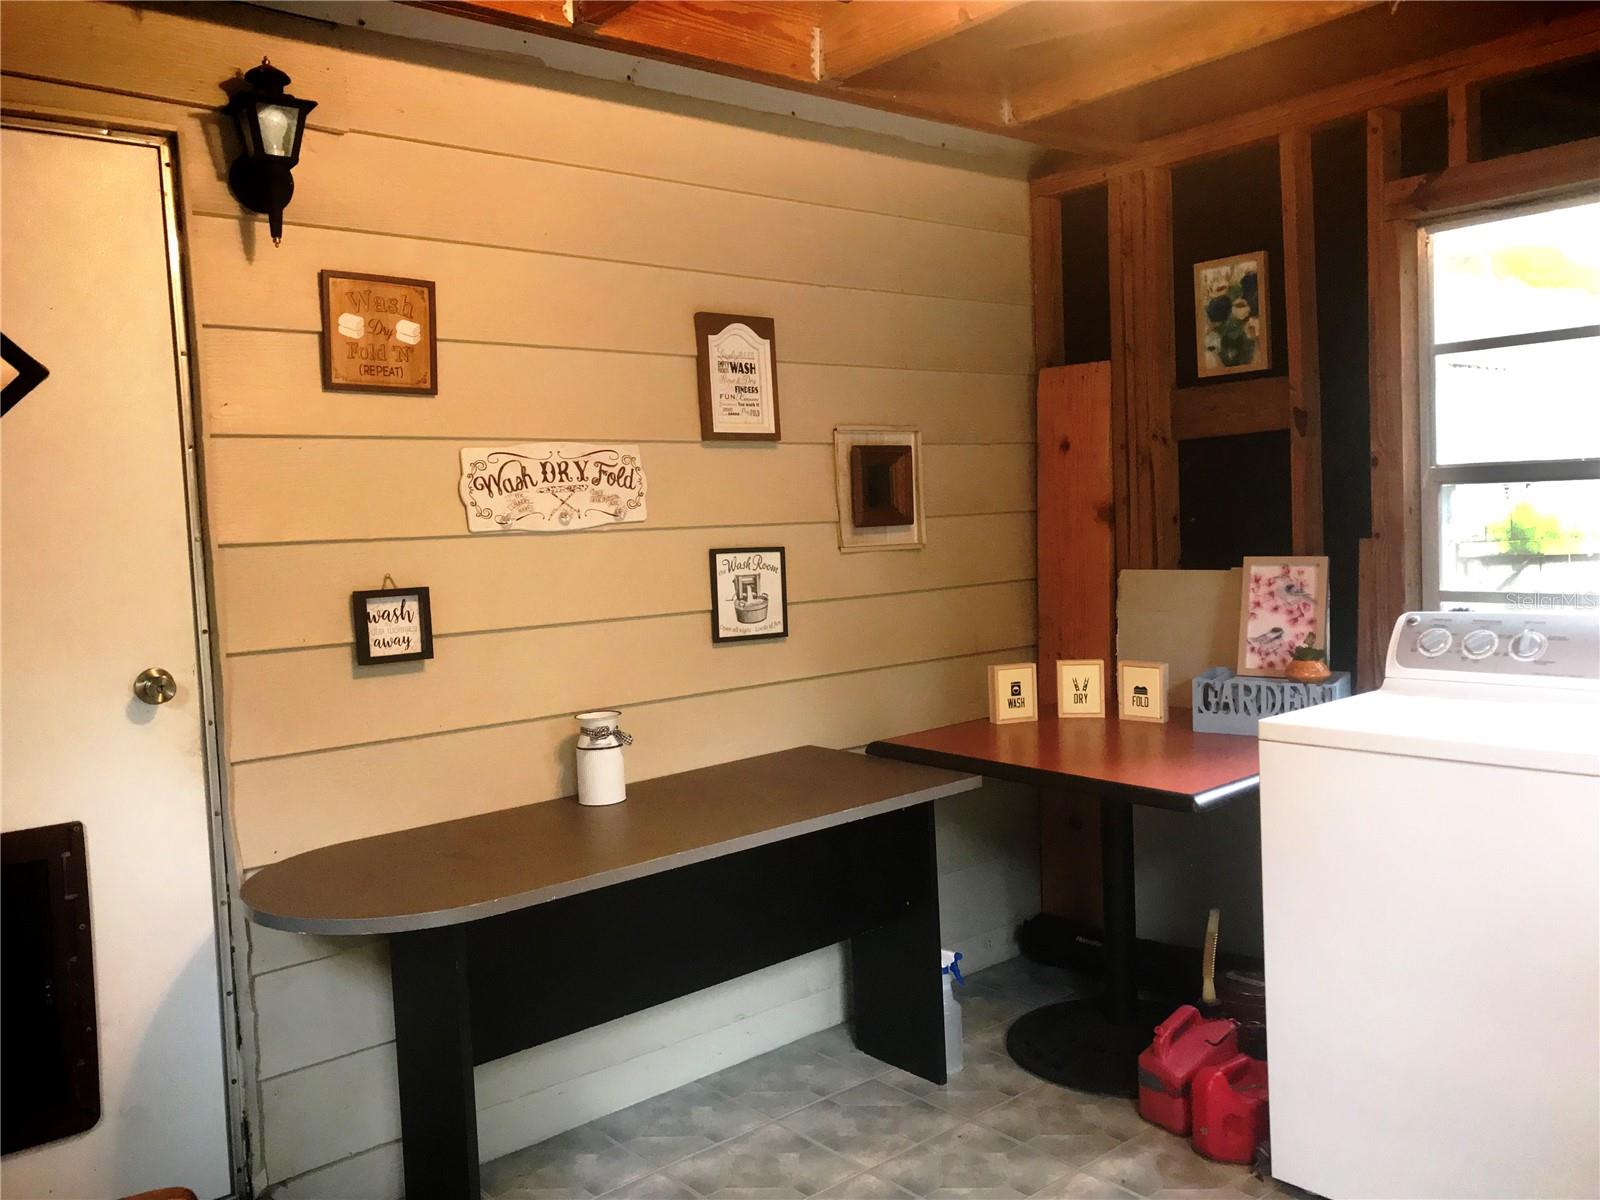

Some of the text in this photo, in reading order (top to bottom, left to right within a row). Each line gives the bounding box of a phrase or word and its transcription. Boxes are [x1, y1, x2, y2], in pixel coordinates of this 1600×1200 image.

[345, 289, 414, 319] Wash
[367, 318, 394, 340] Dry
[346, 342, 388, 361] Fold
[358, 364, 404, 378] (REPEAT)
[729, 361, 757, 375] WASH
[473, 459, 637, 498] Wash DRY Fold
[722, 554, 779, 574] Wash Room
[367, 598, 415, 624] wash
[373, 635, 413, 651] away
[1007, 697, 1026, 709] WASH
[1073, 693, 1089, 704] DRY
[1132, 696, 1149, 708] FOLD
[1201, 681, 1334, 716] GARDEN
